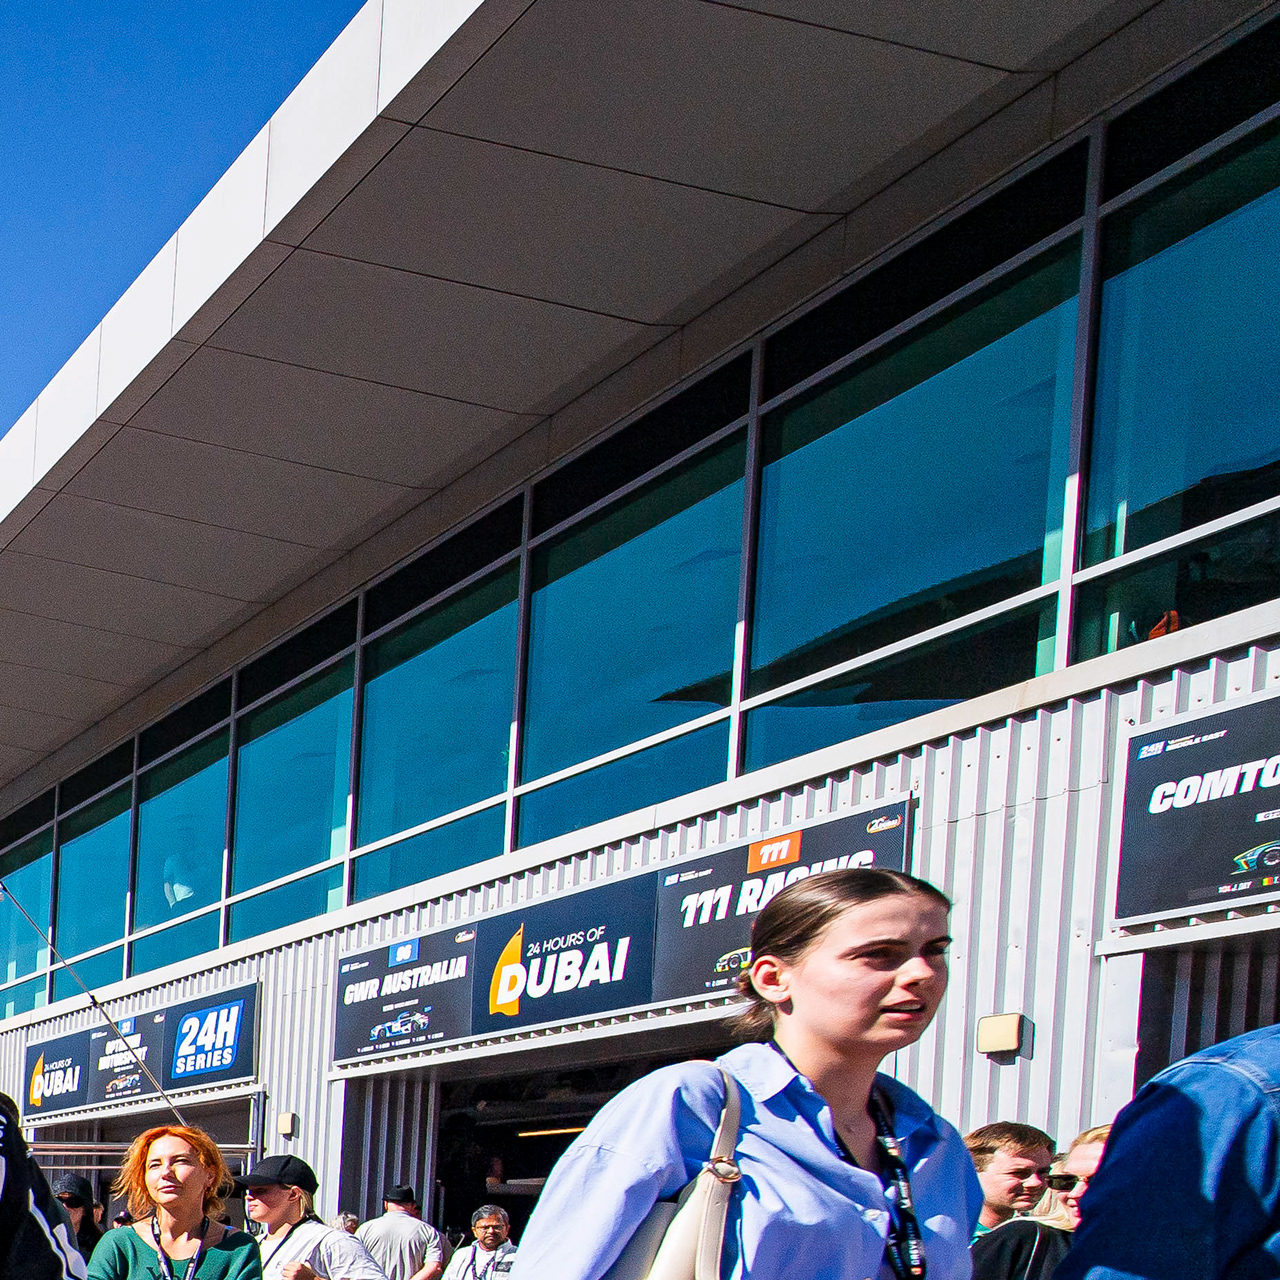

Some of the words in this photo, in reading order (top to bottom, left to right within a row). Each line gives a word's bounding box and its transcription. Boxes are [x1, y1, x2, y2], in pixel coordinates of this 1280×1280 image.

[760, 840, 790, 865] 111
[680, 884, 734, 928] 111
[526, 942, 541, 957] 24
[543, 931, 585, 953] HOURS
[586, 925, 606, 942] OF
[344, 978, 381, 1005] GWR
[380, 956, 468, 996] AUSTRALIA
[496, 936, 631, 1005] DUBAI
[178, 1005, 240, 1057] 24H
[175, 1047, 233, 1074] SERIES
[32, 1065, 81, 1100] DUBAI
